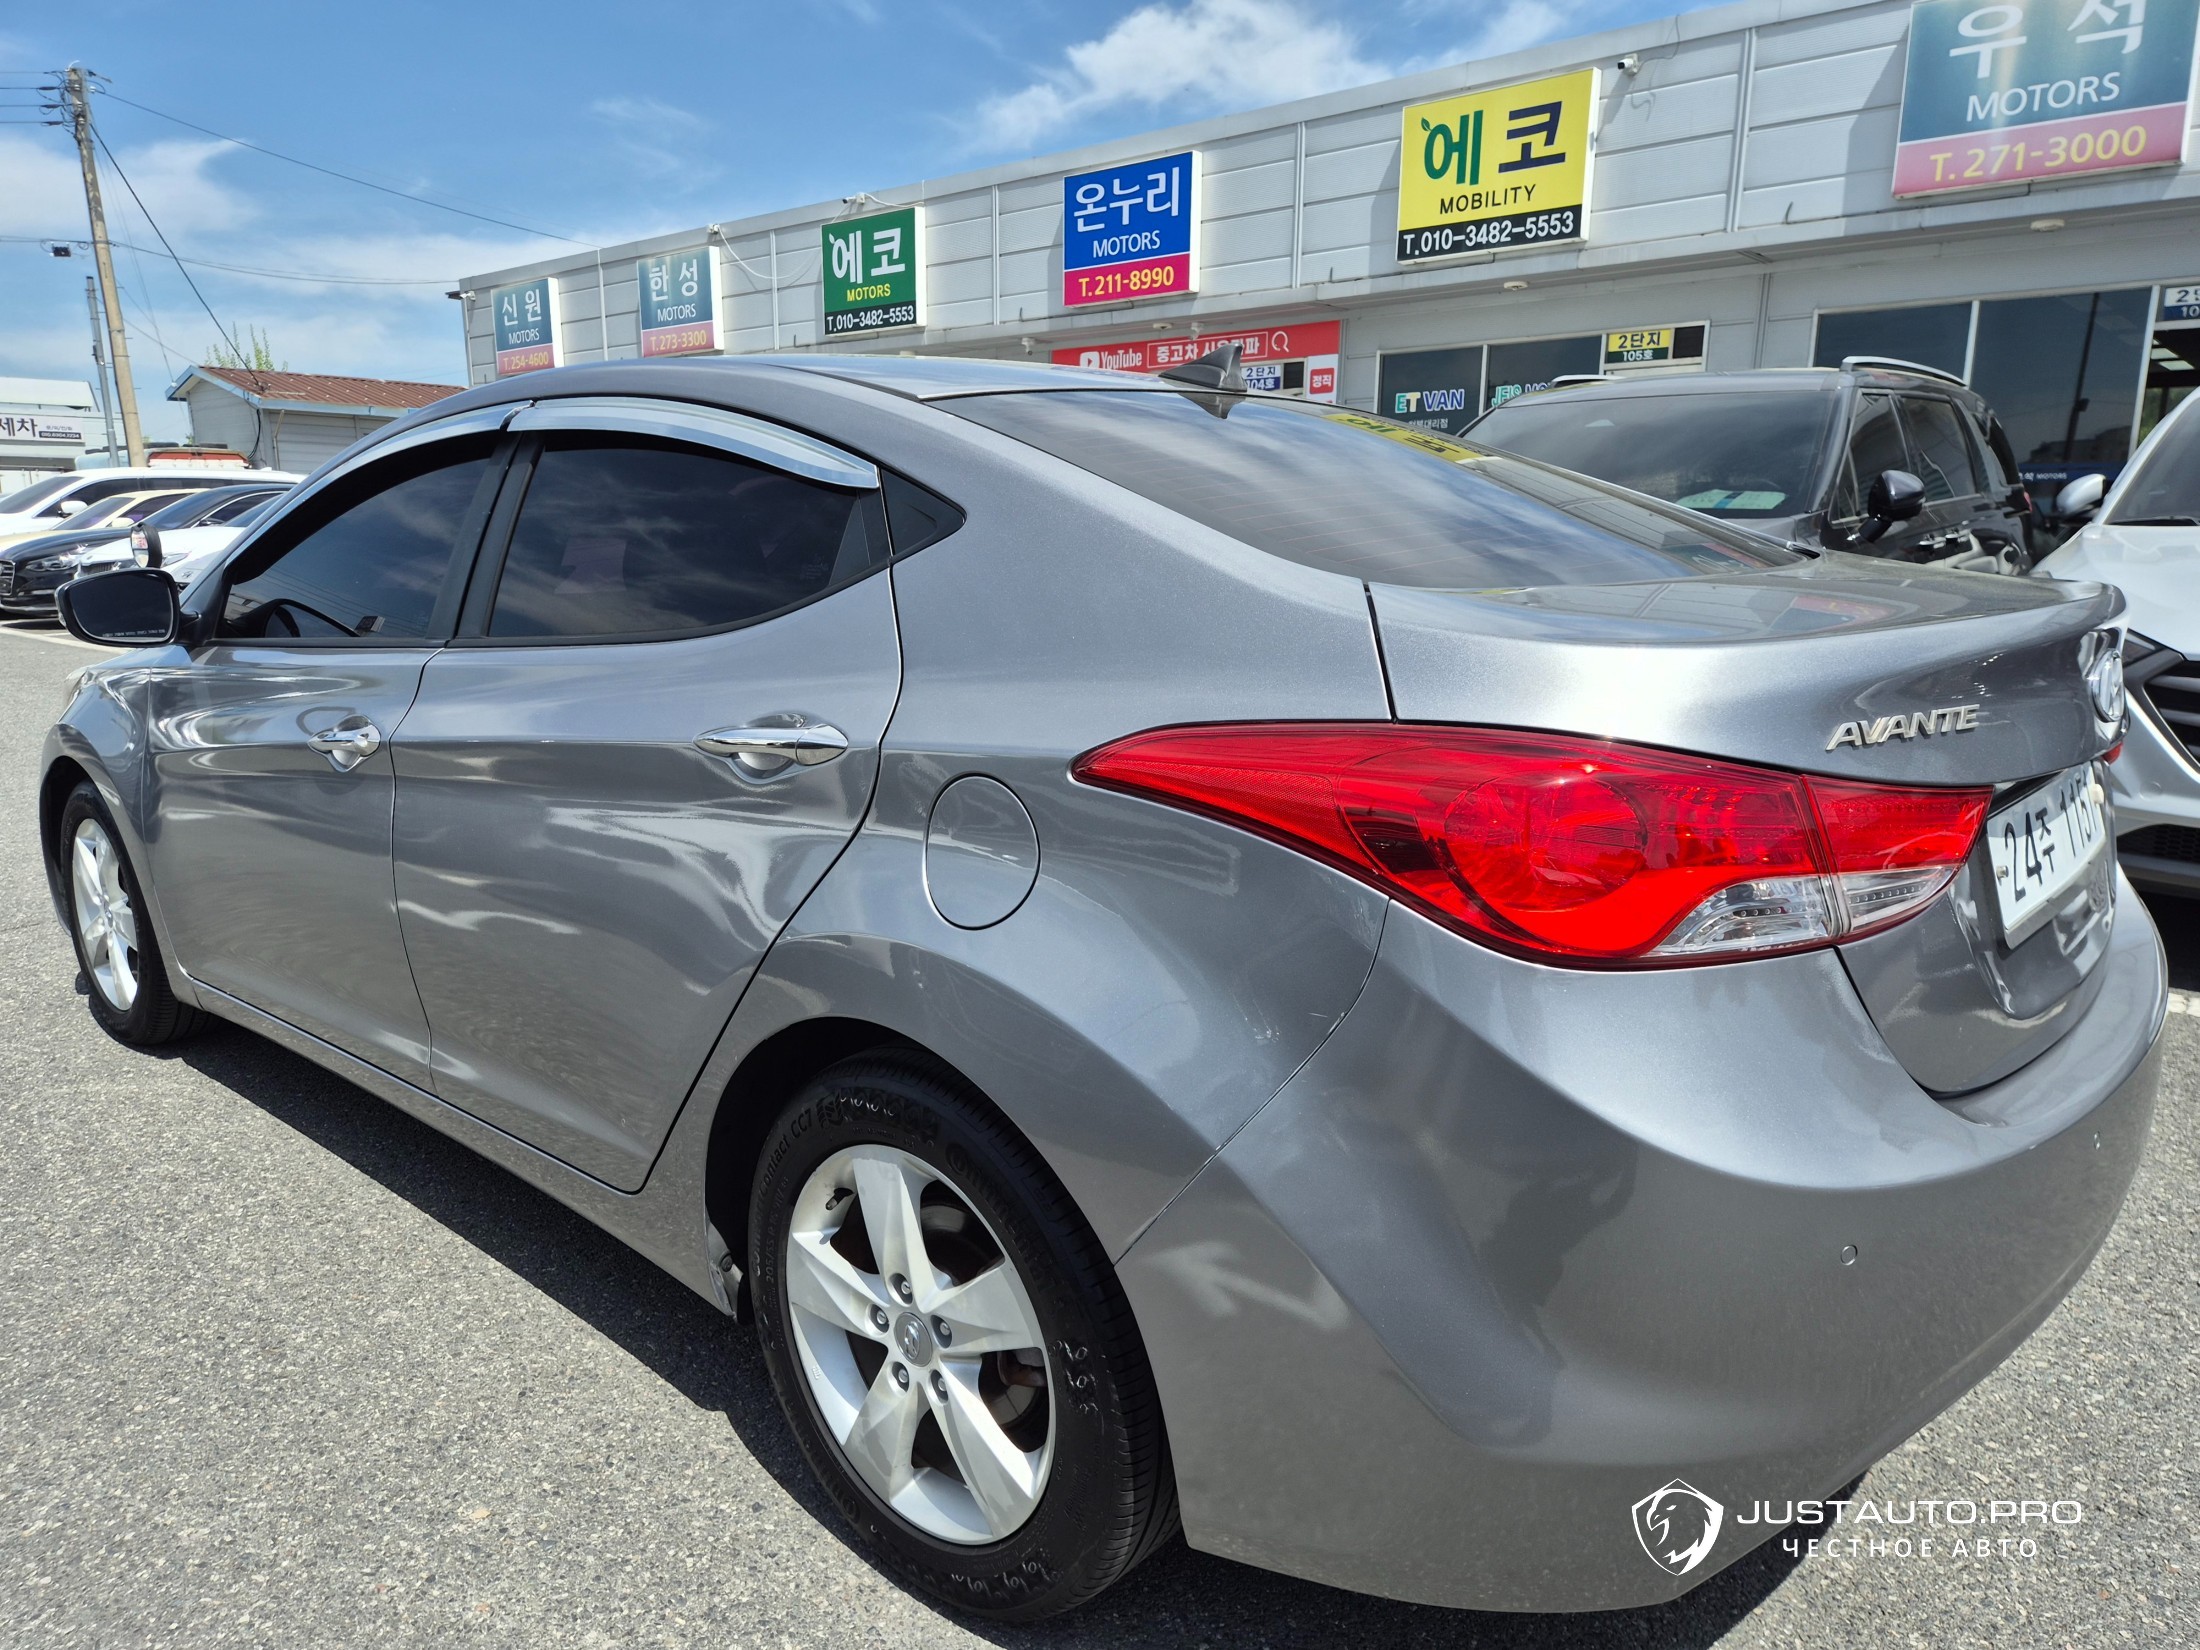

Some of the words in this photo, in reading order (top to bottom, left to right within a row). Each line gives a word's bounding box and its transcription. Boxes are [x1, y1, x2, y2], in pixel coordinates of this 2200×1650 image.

[1949, 0, 2149, 79] 우석
[1966, 71, 2121, 123] MOTORS
[1423, 101, 1566, 185] 에코
[1929, 125, 2147, 183] T.271-3000
[1073, 167, 1180, 232] 온누리
[1440, 184, 1537, 214] MOBILITY
[1093, 230, 1161, 258] MOTORS
[1403, 211, 1574, 256] T.010-3482-5553
[829, 228, 906, 283] 에코
[649, 259, 699, 301] 한성
[847, 283, 891, 302] MOTORS
[1079, 266, 1174, 297] T.211-8990
[500, 288, 542, 326] 신원
[657, 303, 697, 322] MOTORS
[827, 305, 914, 333] T.010-3482-5553
[508, 327, 540, 344] MOTORS
[650, 330, 707, 352] T.273-3300
[503, 352, 549, 371] T.254-4600
[1101, 350, 1142, 370] YouTube
[1157, 344, 1199, 363] 중고차
[1395, 392, 1422, 413] ET
[1423, 389, 1465, 412] VAN
[1824, 703, 1982, 751] AVANTE
[2004, 806, 2056, 903] 24주
